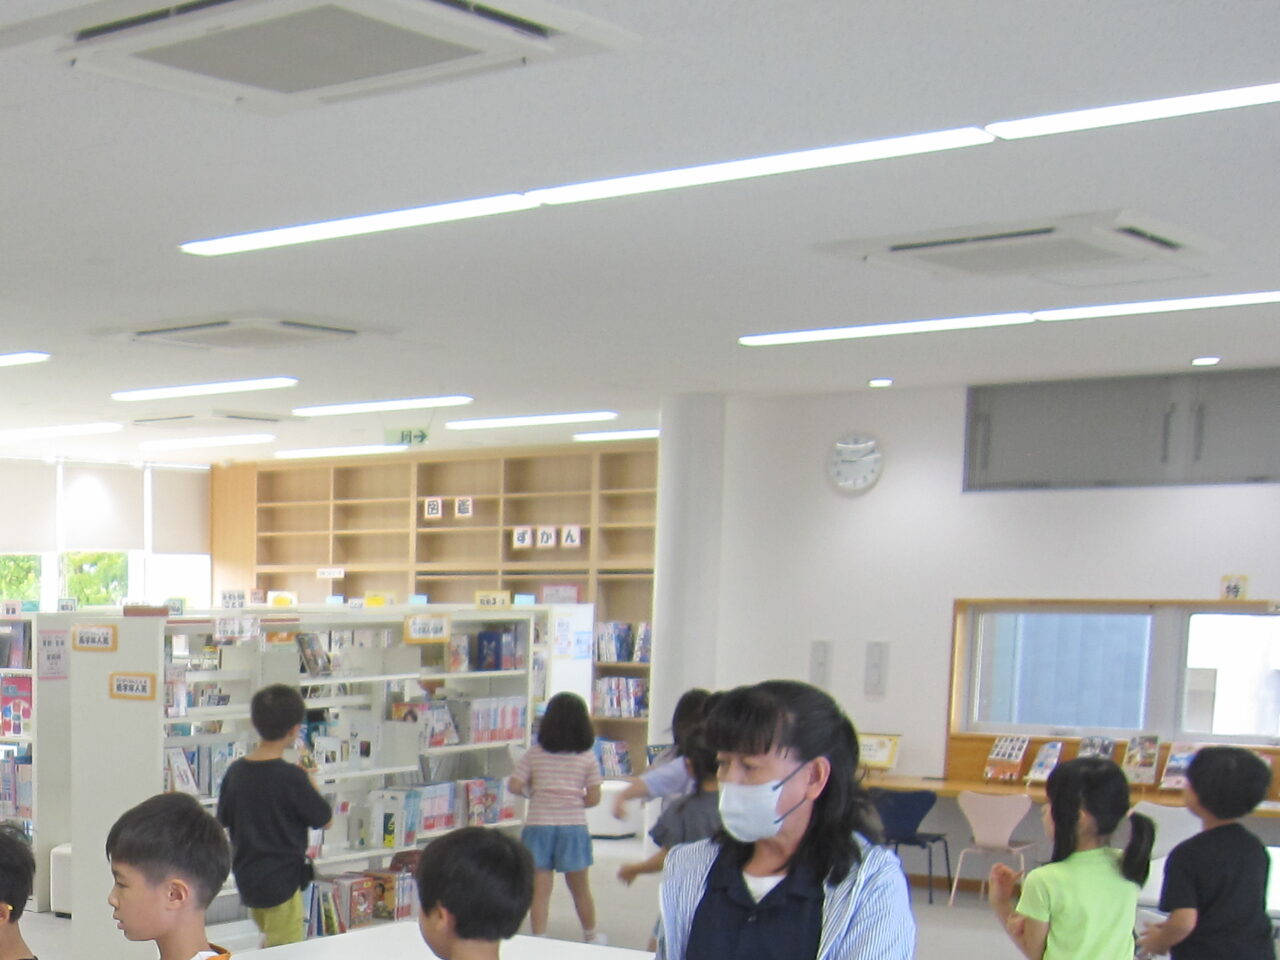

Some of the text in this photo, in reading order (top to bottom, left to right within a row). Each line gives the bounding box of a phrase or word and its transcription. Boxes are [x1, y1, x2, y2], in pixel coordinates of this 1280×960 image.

[426, 499, 470, 516] 図鑑
[516, 530, 576, 545] ずかん
